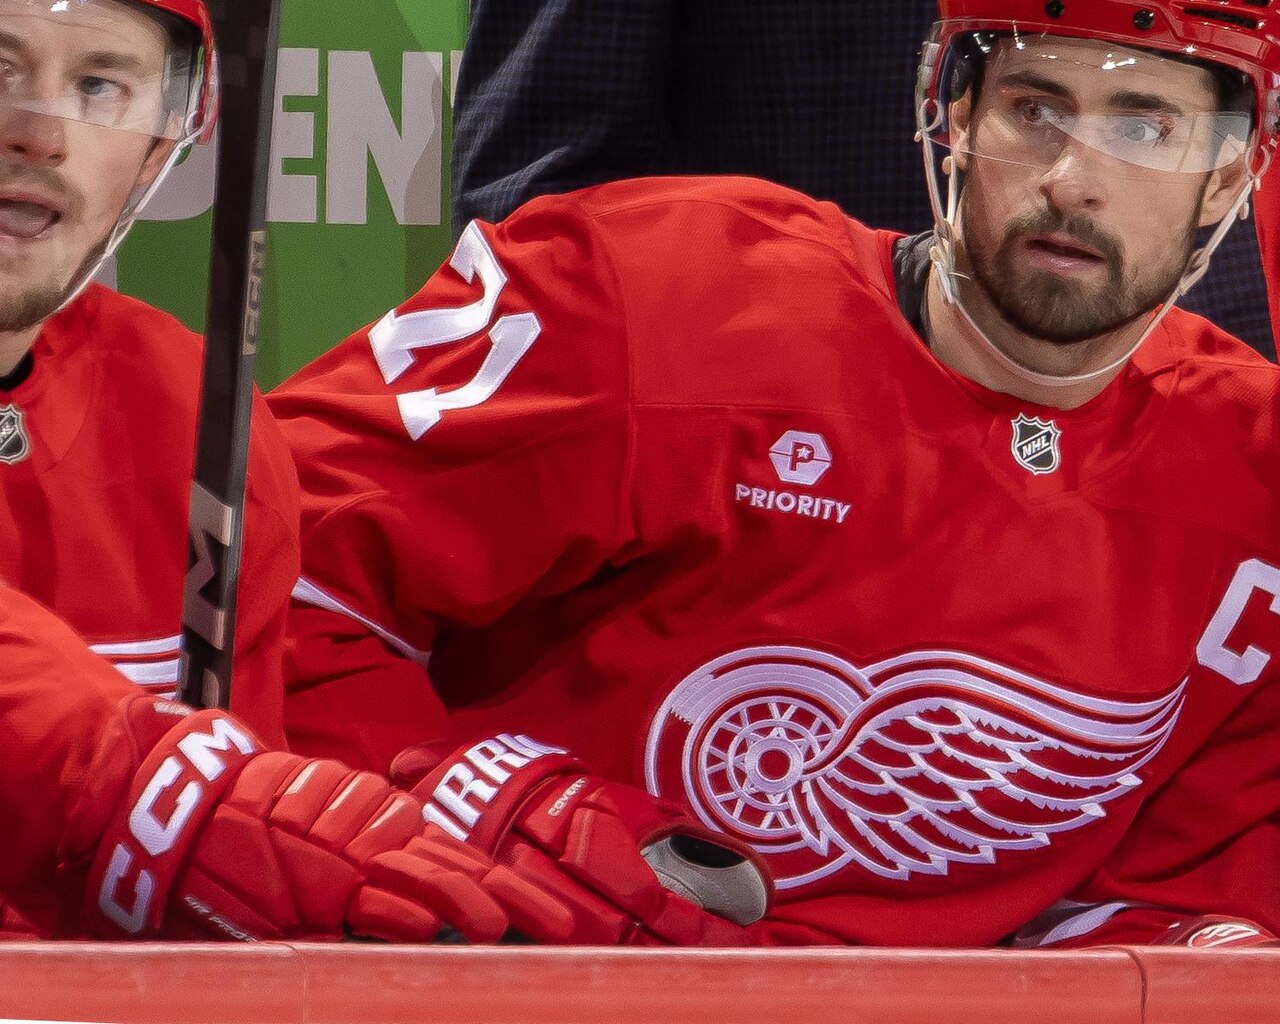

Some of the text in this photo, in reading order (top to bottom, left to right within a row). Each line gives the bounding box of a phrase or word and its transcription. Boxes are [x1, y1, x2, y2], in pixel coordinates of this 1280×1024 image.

[367, 218, 542, 441] 71
[735, 482, 852, 524] PRIORITY
[1021, 435, 1050, 459] NHL
[98, 717, 256, 934] CCM
